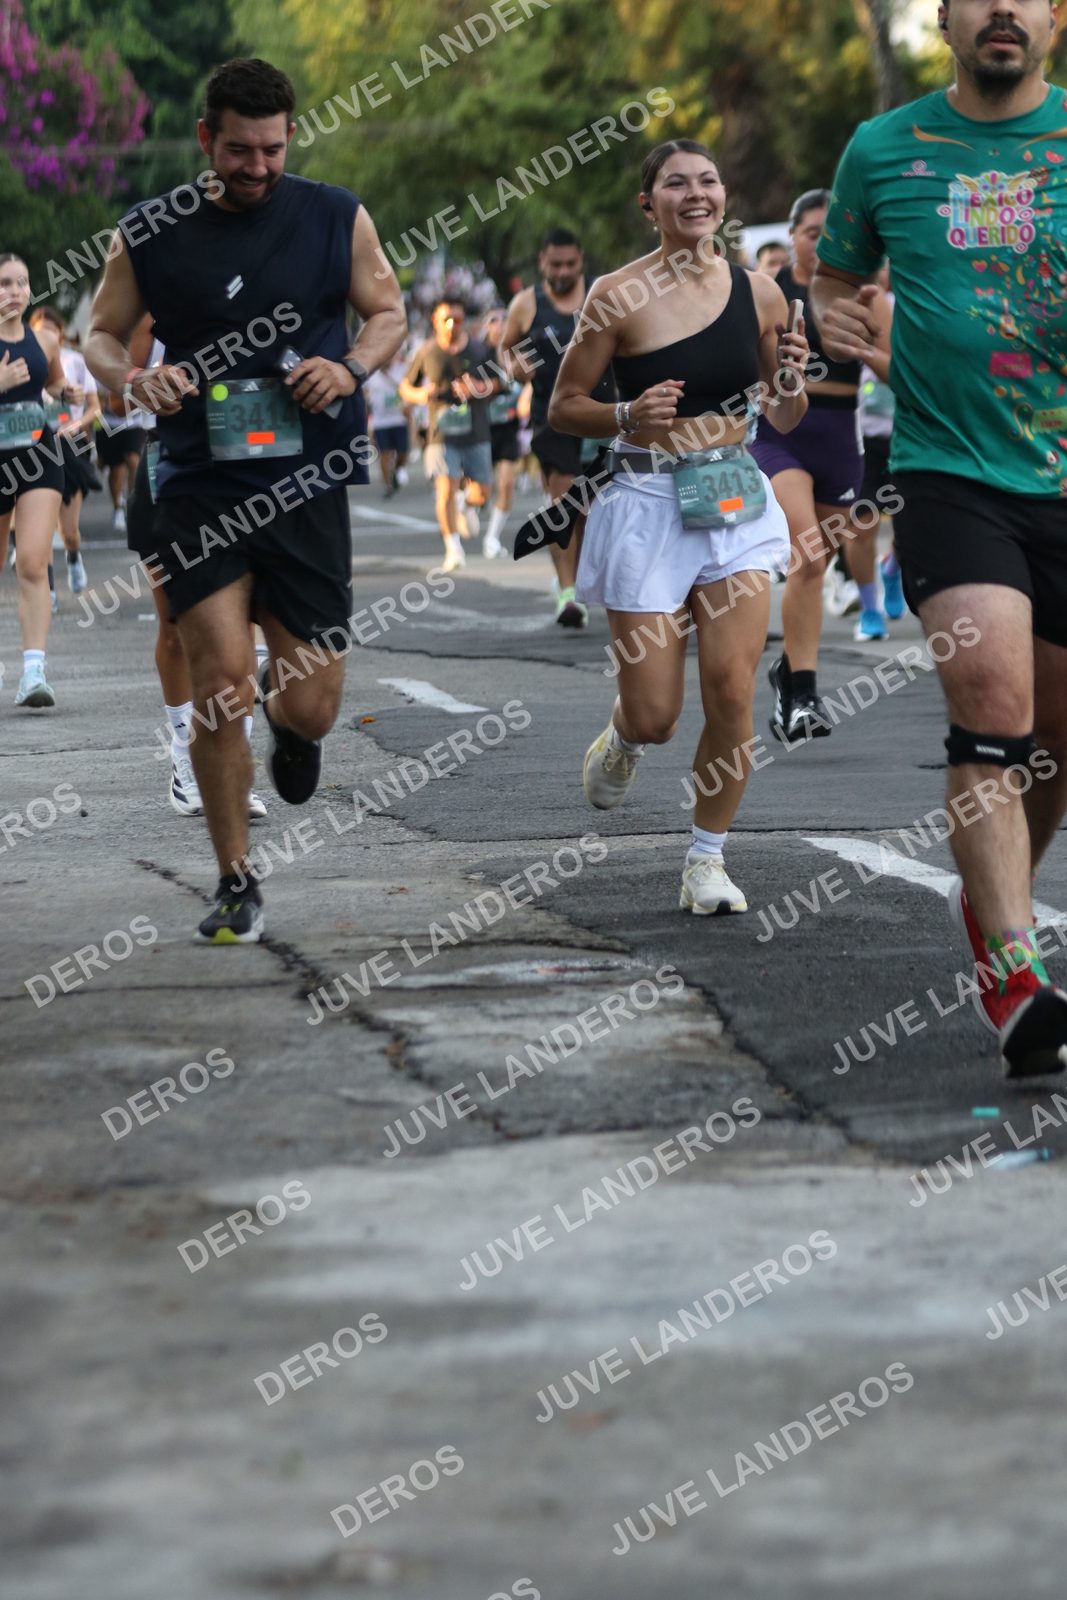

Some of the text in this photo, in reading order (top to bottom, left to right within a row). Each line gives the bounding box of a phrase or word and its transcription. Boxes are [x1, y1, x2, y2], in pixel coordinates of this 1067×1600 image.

[951, 206, 1016, 228] LINDO
[950, 222, 1034, 249] QUERIDO
[702, 465, 761, 503] 3413
